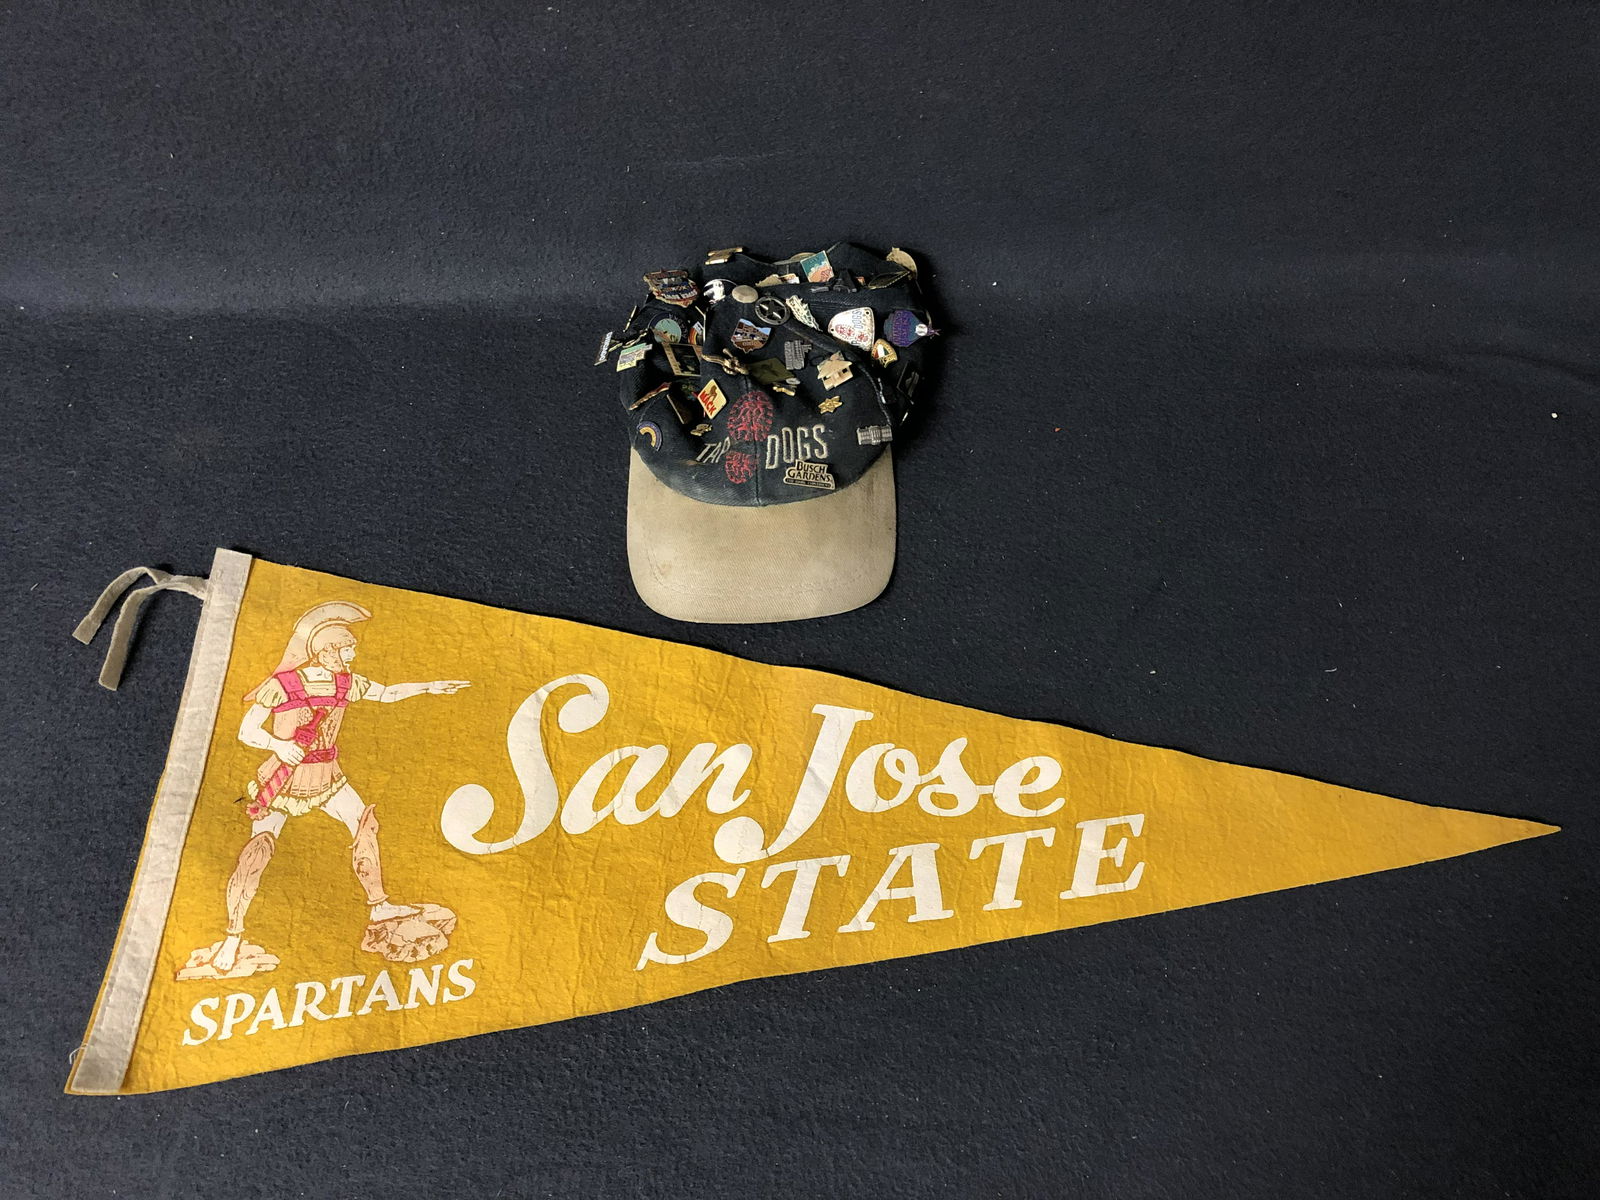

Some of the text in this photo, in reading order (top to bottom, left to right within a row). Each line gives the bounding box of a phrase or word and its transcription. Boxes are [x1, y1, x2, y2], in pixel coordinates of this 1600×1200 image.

[699, 390, 717, 416] MACK
[696, 436, 731, 464] TAP
[765, 423, 829, 470] DOGS
[796, 460, 826, 474] BUSCH
[787, 468, 832, 482] GARDENS
[441, 673, 1066, 865] San Jose
[636, 813, 1146, 971] STATE
[181, 958, 477, 1046] SPARTANS
